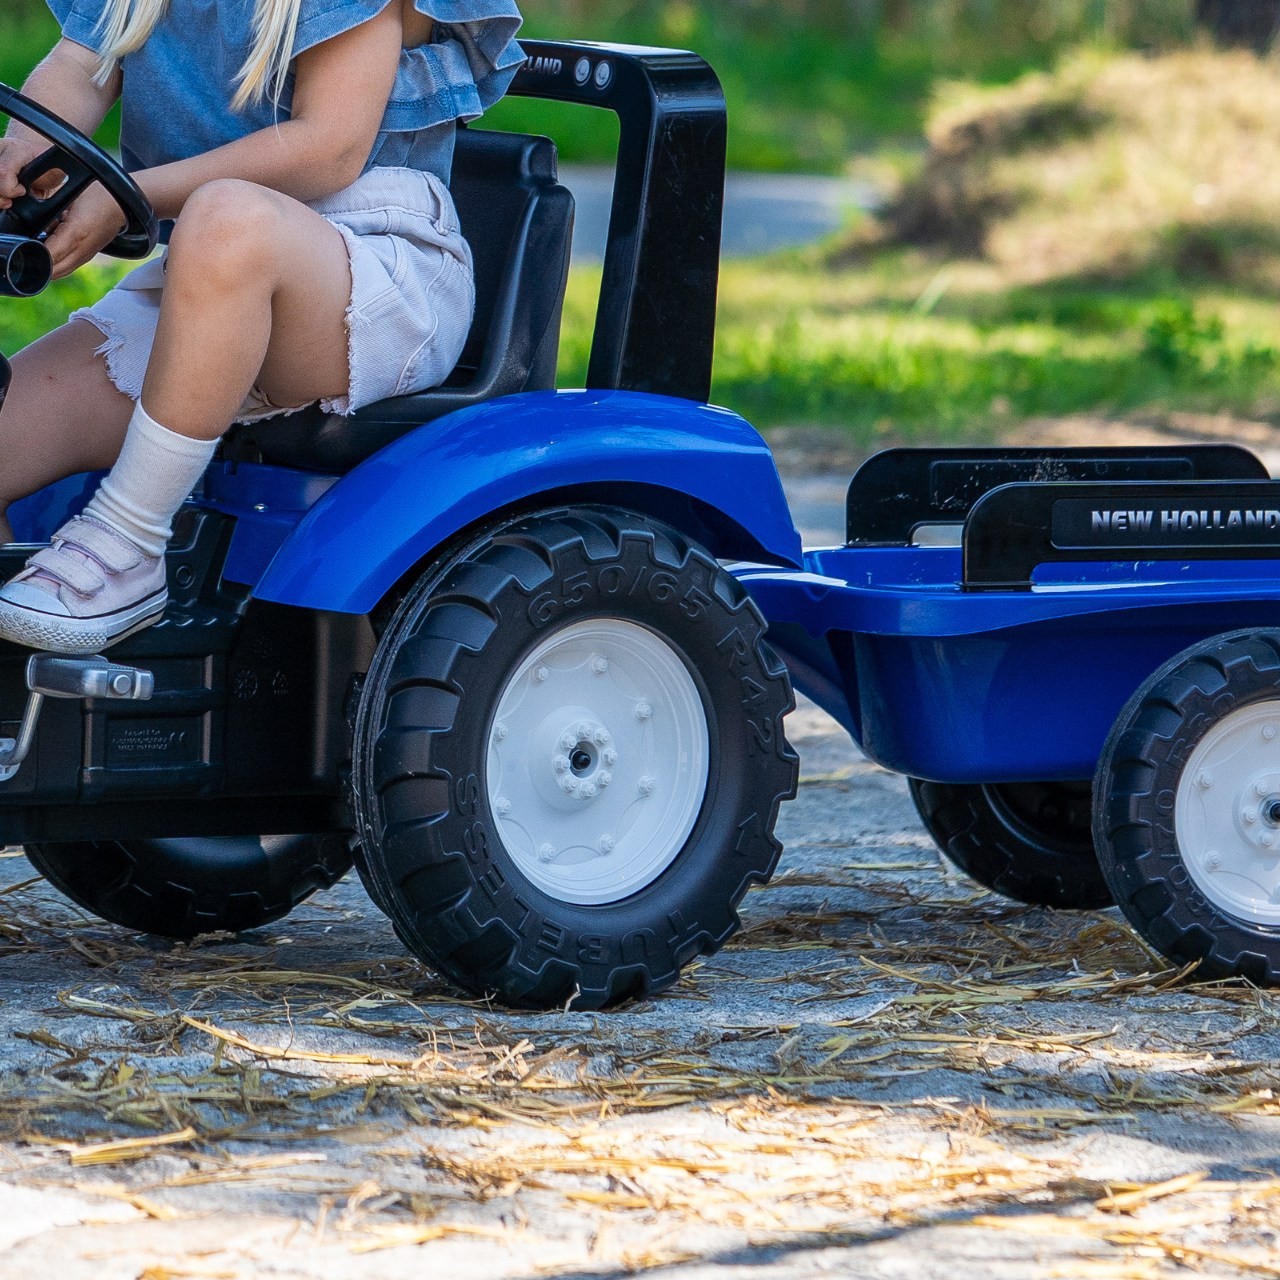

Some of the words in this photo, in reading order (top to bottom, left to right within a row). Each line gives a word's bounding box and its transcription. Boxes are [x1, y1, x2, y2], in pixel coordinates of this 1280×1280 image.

[1091, 510, 1153, 532] NEW
[1160, 510, 1280, 532] HOLLAND
[527, 565, 713, 629] 650/65
[717, 627, 774, 756] R42
[454, 773, 700, 966] TUBELESS
